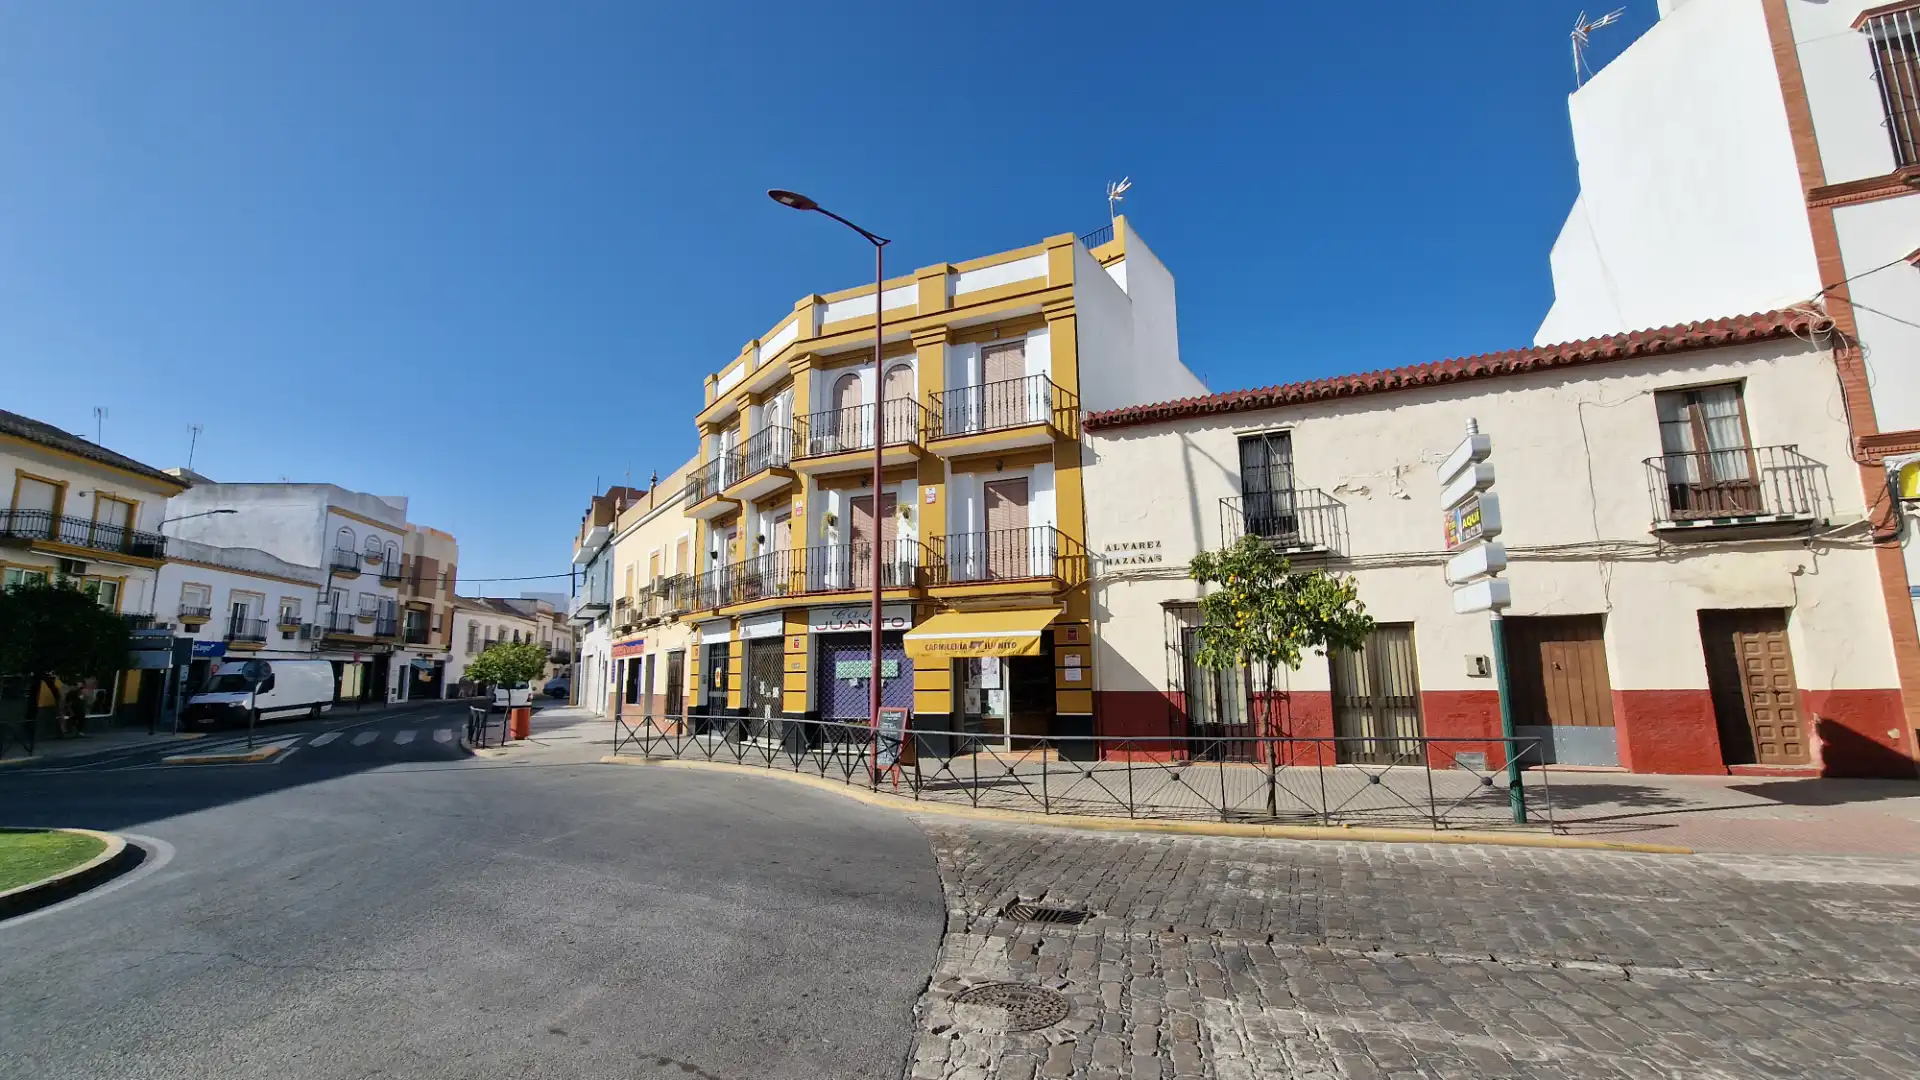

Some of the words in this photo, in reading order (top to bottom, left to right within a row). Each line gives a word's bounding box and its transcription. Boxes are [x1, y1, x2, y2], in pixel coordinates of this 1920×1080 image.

[1105, 540, 1162, 552] ALVAREZ
[1105, 553, 1163, 566] HAZAÑAS
[831, 608, 873, 620] Cas
[815, 617, 905, 631] JUANTO
